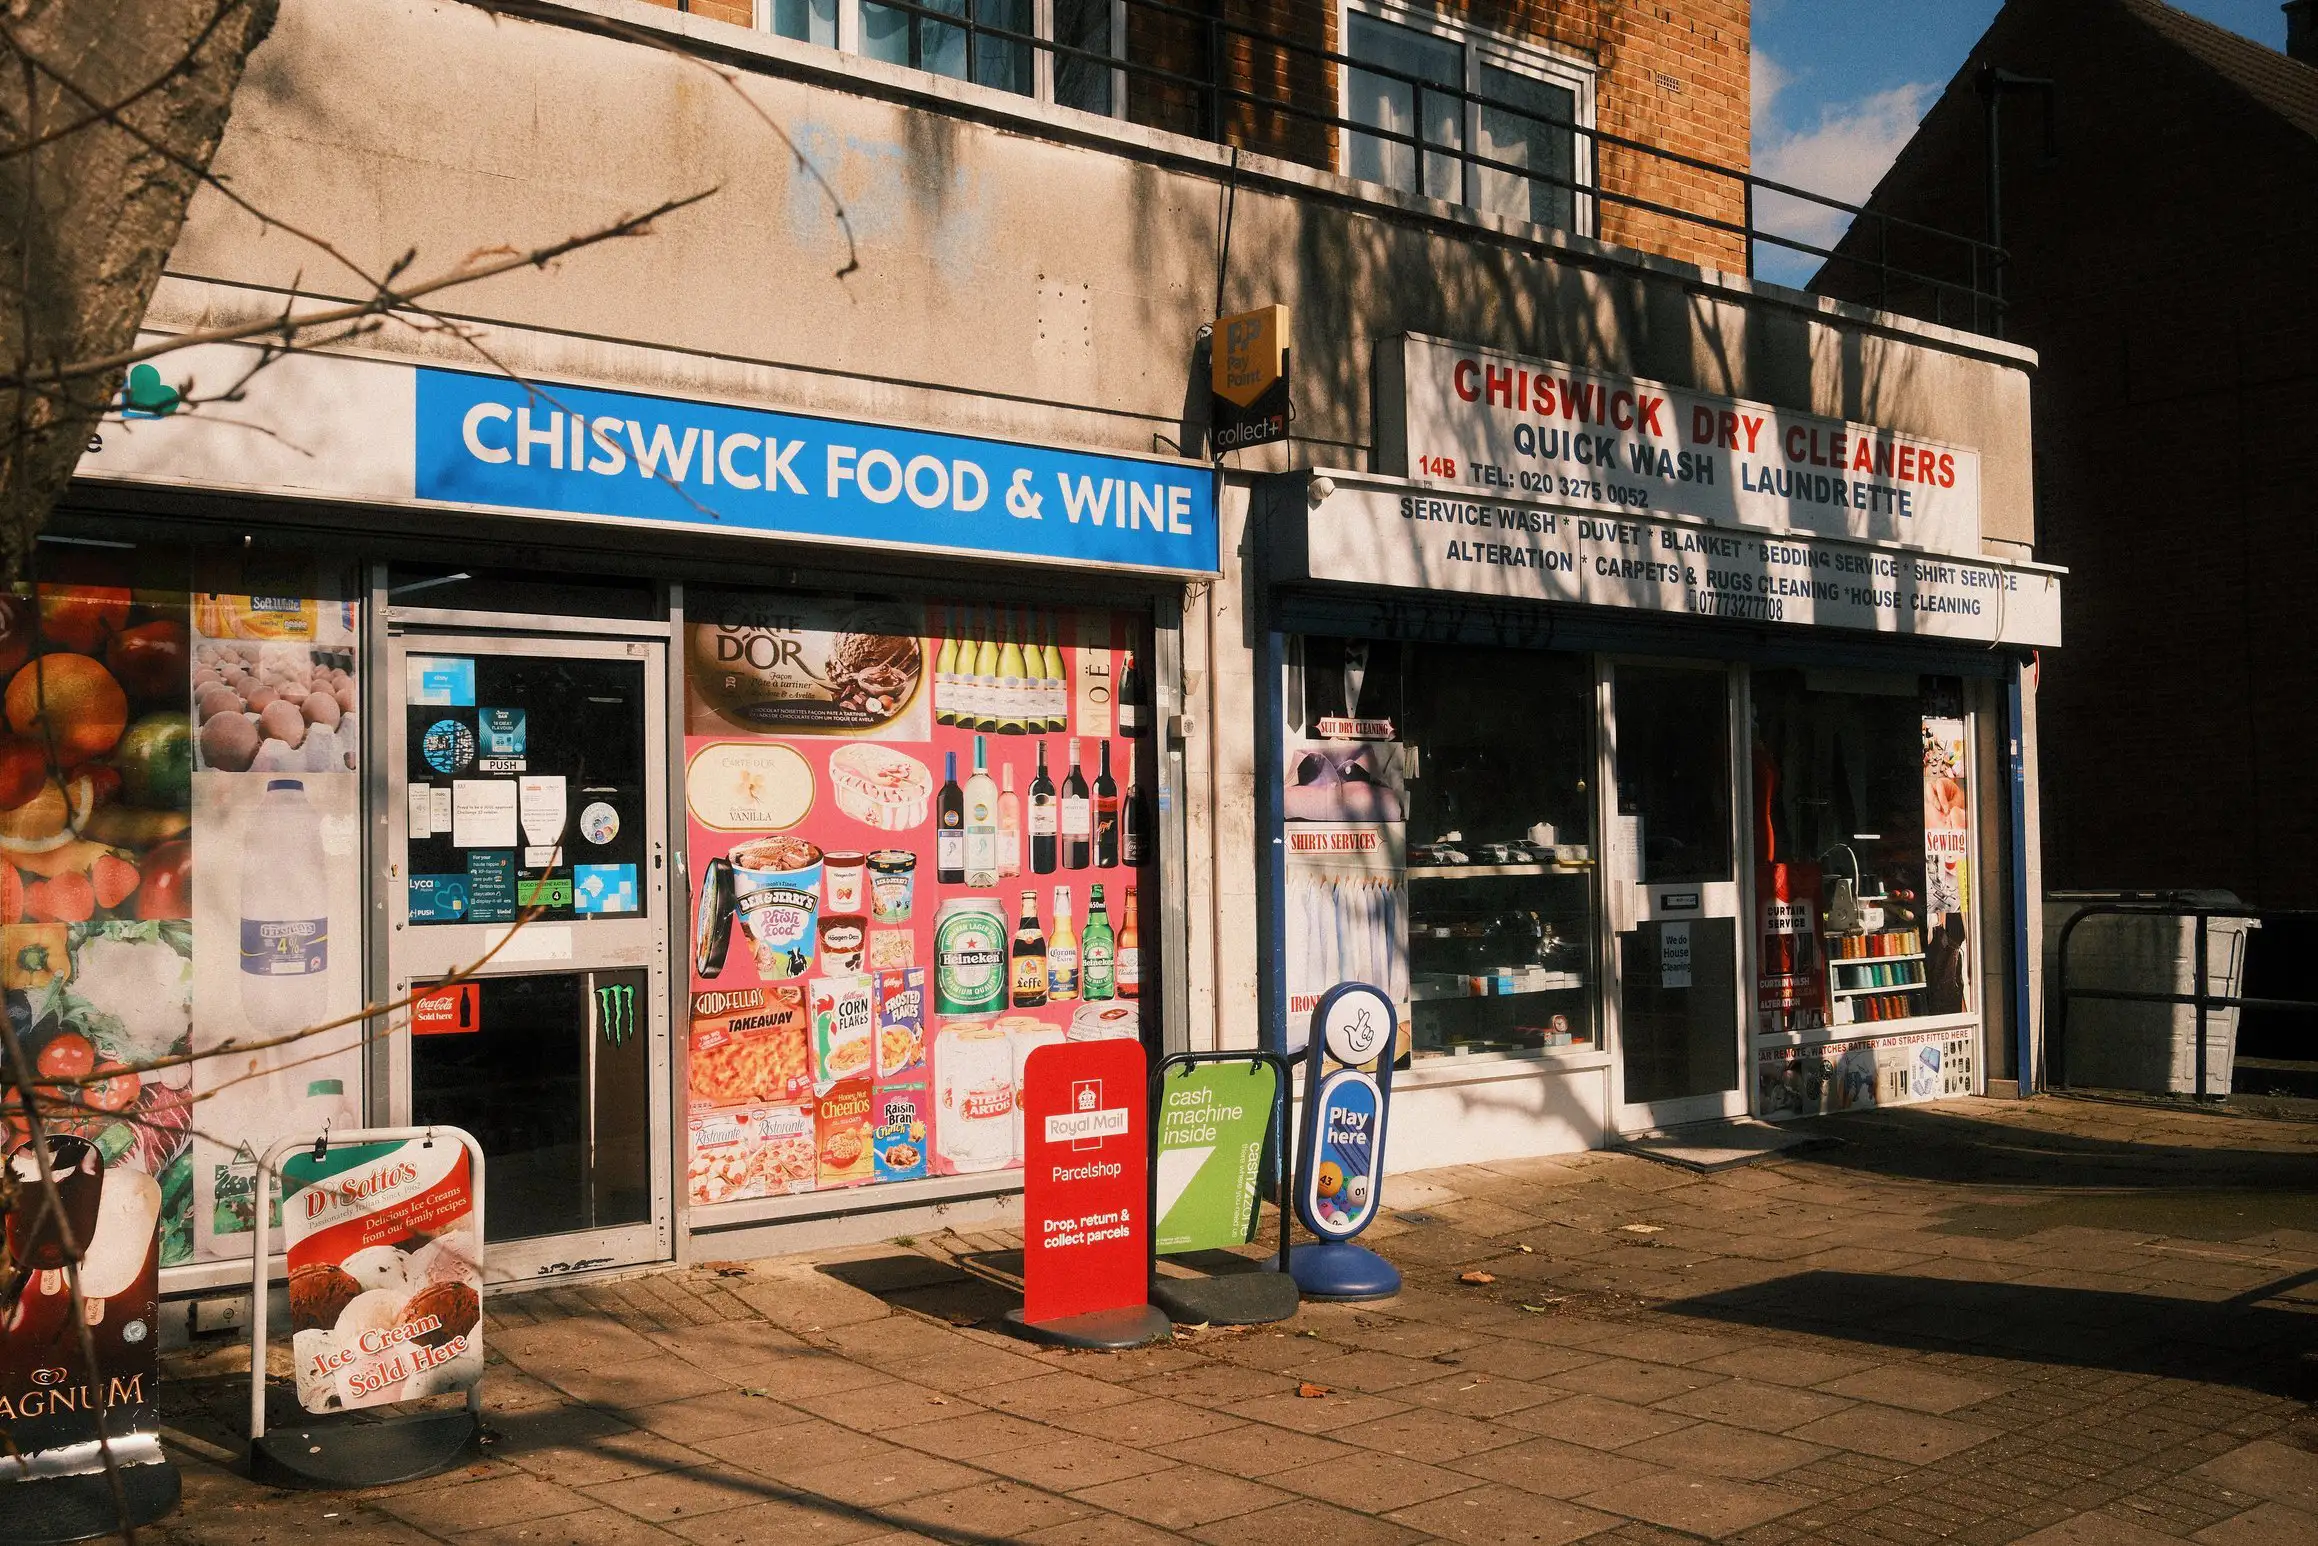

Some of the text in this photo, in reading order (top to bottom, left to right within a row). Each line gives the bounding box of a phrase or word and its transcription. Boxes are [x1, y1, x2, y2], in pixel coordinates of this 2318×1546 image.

[1454, 358, 1955, 489] CHISWICK DRY CLEANERS
[462, 402, 1193, 535] CHISWICK FOOD & WINE
[1513, 423, 1912, 518] QUICK WASH LAUNDRETTE
[1419, 454, 1649, 509] 14B TEL: 020 3275 0052
[1400, 498, 2017, 592] SERVICE WASH DUVET BLANKET BEDDING SERVICE SHIRT SERVICE
[1446, 539, 1573, 572] ALTERATION
[1595, 556, 1679, 584] CARPETS
[1685, 567, 1698, 586] &
[1706, 569, 1753, 594] RUGS
[1758, 576, 1839, 601] CLEANING
[1911, 593, 1981, 615] CLEANING
[253, 597, 271, 610] Soft
[1700, 590, 1783, 621] 07773277708
[1320, 721, 1389, 735] SUIT DRY CLEANING
[489, 761, 517, 770] PUSH
[729, 812, 772, 821] VANILLA
[1290, 833, 1376, 850] SHIRTS SERVICES
[1927, 831, 1965, 854] Sewing
[409, 879, 434, 890] Lyca
[773, 891, 814, 909] JERRY'S
[761, 909, 800, 927] Phish
[1767, 905, 1806, 917] CURTAIN
[1768, 917, 1806, 929] SERVICE
[1665, 934, 1688, 945] We do
[944, 953, 1000, 965] Heineken
[1050, 949, 1076, 957] Corona
[1663, 947, 1689, 958] House
[1662, 962, 1691, 973] Cleaning
[1017, 977, 1042, 989] Leffe
[696, 988, 764, 1014] GOODFELLA'S
[838, 998, 868, 1017] CORN
[885, 990, 920, 1014] FROSTED
[1760, 997, 1801, 1009] ALTERATION
[418, 1012, 453, 1021] Sold here
[728, 1011, 793, 1032] TAKEAWAY
[839, 1014, 868, 1030] FLAKES
[892, 1004, 919, 1023] FLAKES
[1811, 1029, 1969, 1056] WATCHES BATTERY AND STRAPS FITTED HERE
[838, 1091, 867, 1102] Honey Nut
[970, 1091, 1010, 1105] STELLA
[1169, 1086, 1212, 1106] cash
[821, 1099, 870, 1119] Cheerios
[885, 1103, 915, 1115] Raisin
[970, 1100, 1010, 1115] ARTOIS
[1166, 1104, 1243, 1125] machine
[759, 1119, 805, 1136] Ristorante
[889, 1114, 912, 1126] Bran
[1050, 1112, 1124, 1137] Royal Mail
[1329, 1107, 1369, 1130] Play
[696, 1127, 741, 1146] Ristorante
[1163, 1124, 1217, 1145] inside
[1327, 1127, 1367, 1145] here
[1052, 1161, 1122, 1182] Parcelshop
[1320, 1175, 1333, 1186] 43
[1355, 1187, 1365, 1197] 01
[308, 1209, 353, 1230] Passionately
[381, 1192, 402, 1204] Since
[365, 1187, 461, 1231] Delicious Ice Creams
[362, 1197, 467, 1245] from our family recipes
[1044, 1208, 1130, 1233] Drop, return &
[1044, 1225, 1130, 1248] collect parcels
[311, 1313, 443, 1378] Ice Cream
[348, 1335, 468, 1399] Sold Here
[0, 1372, 144, 1420] AGNUM
